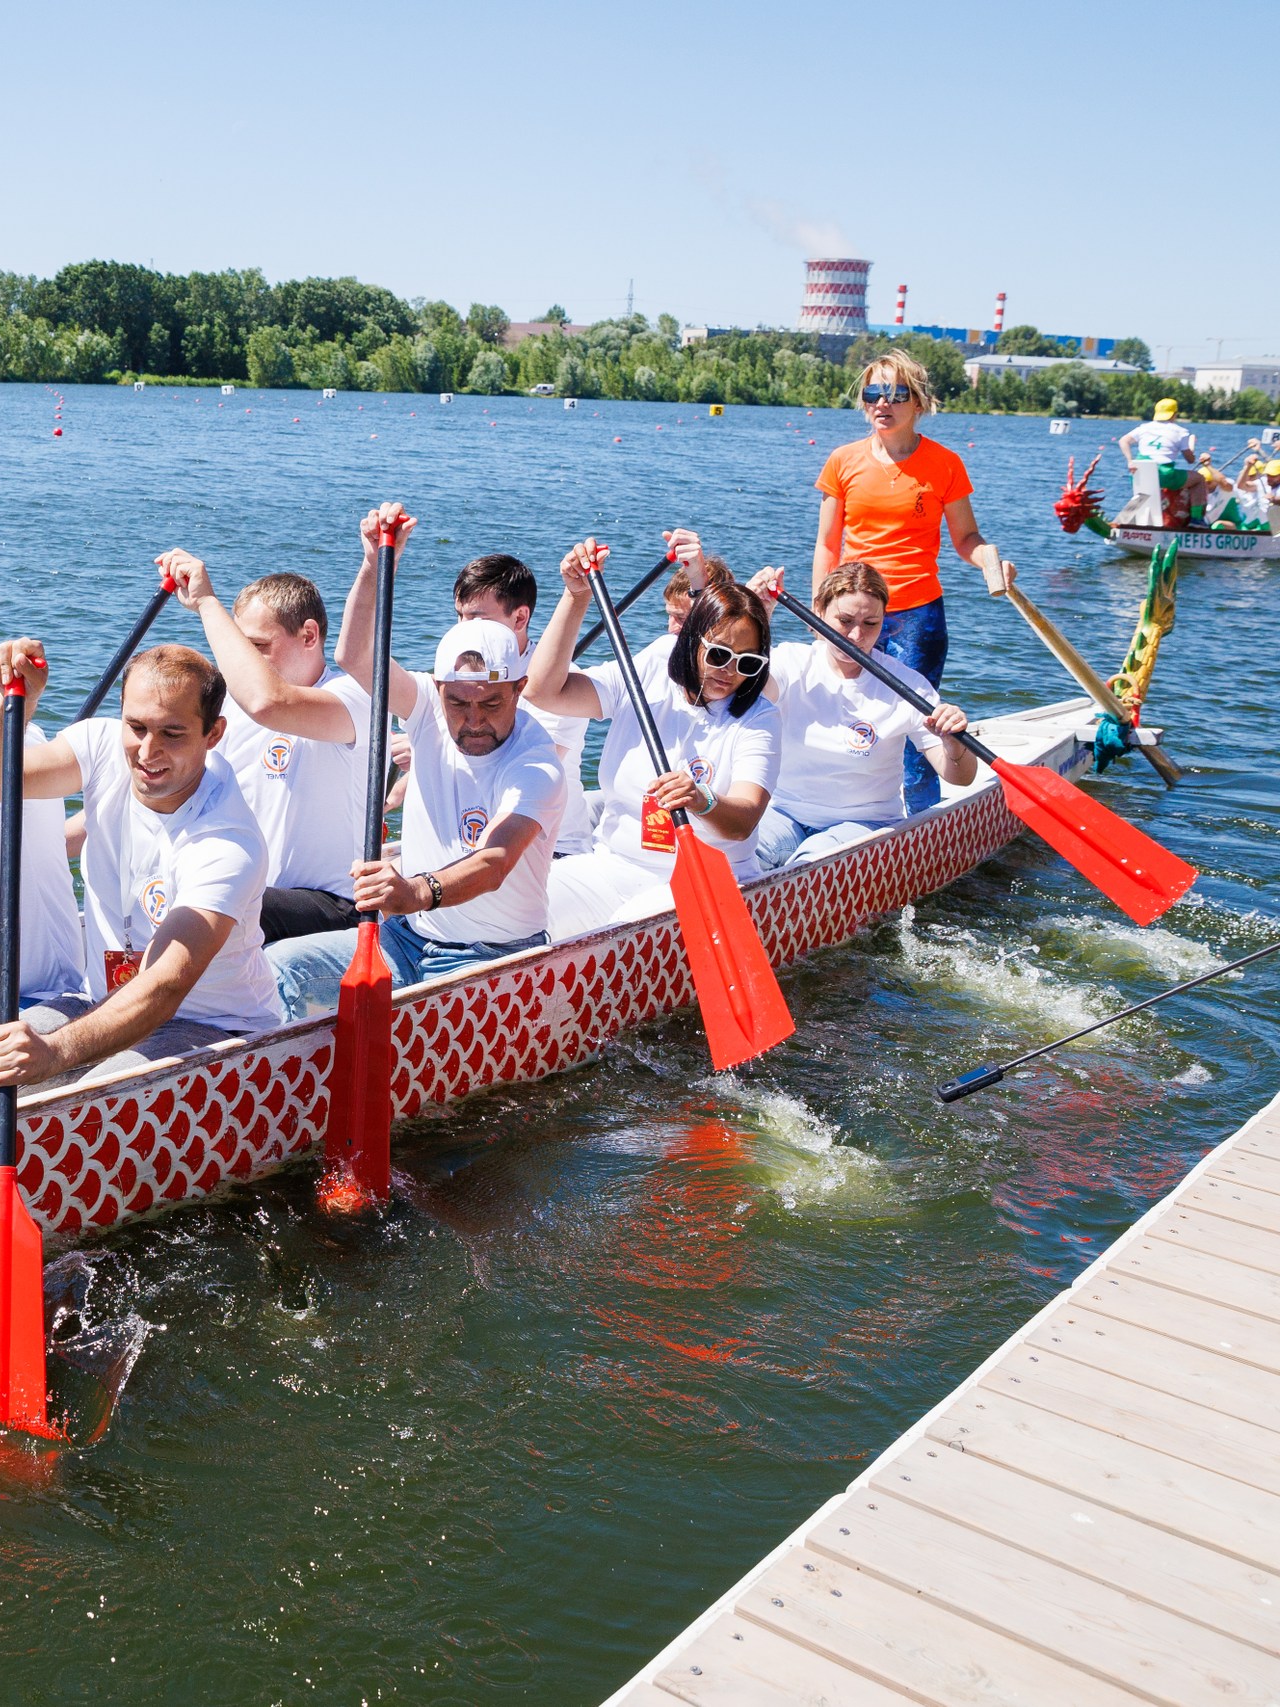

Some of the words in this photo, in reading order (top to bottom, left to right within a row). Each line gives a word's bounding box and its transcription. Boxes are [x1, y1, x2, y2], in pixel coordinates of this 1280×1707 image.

[715, 406, 722, 415] 5
[1147, 434, 1163, 450] 4
[1174, 533, 1212, 549] NEFIS
[1215, 535, 1258, 551] GROUP
